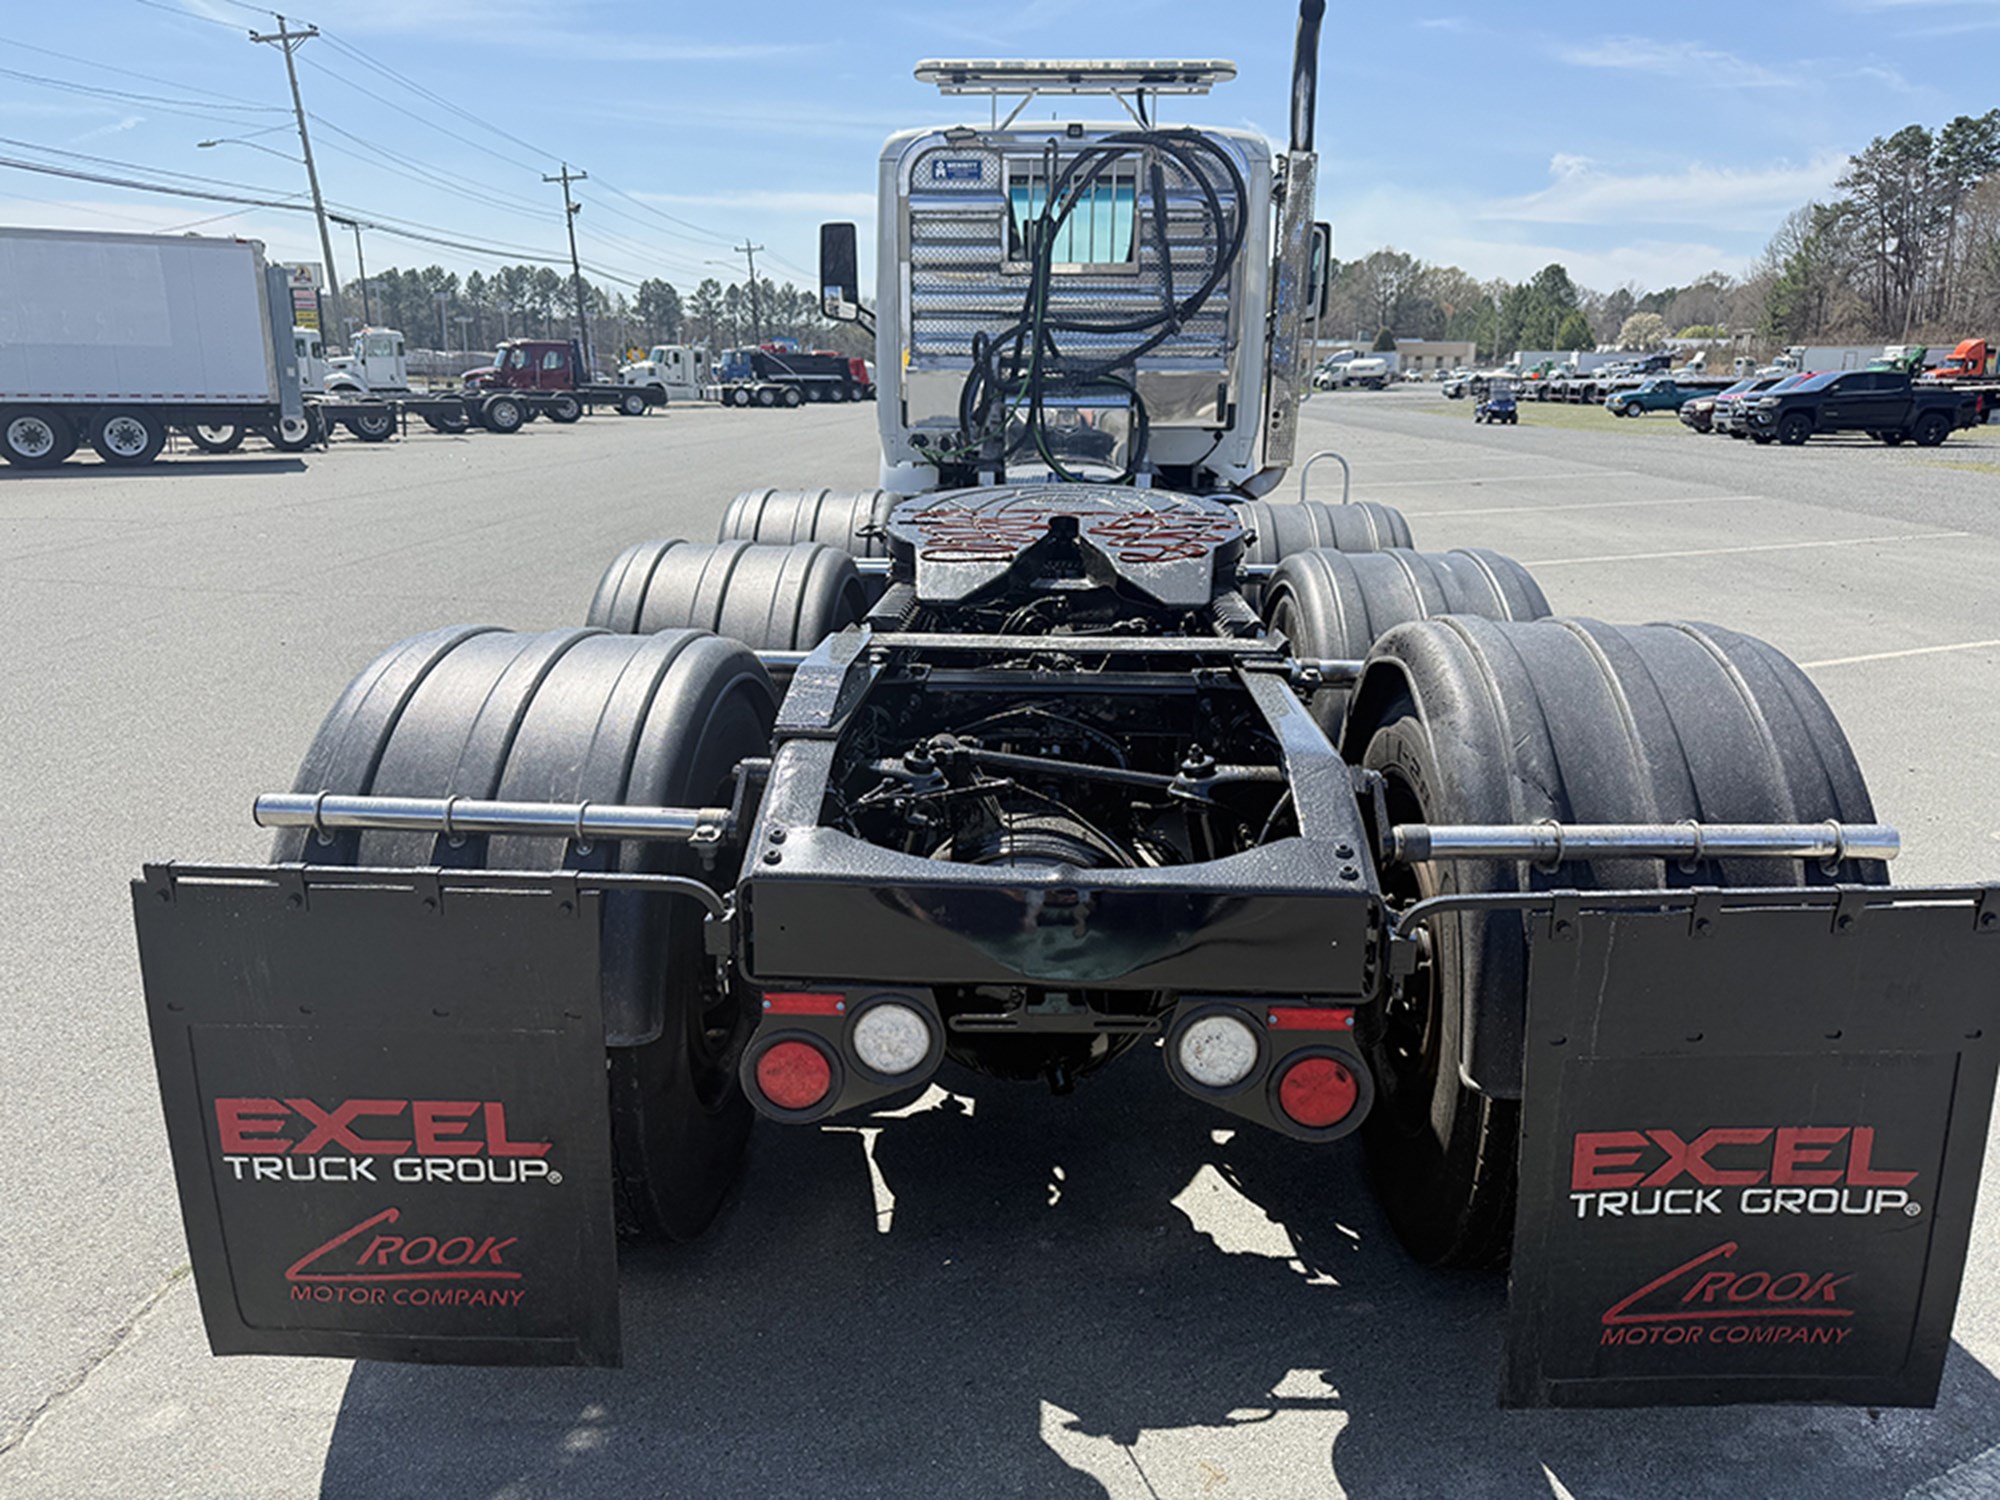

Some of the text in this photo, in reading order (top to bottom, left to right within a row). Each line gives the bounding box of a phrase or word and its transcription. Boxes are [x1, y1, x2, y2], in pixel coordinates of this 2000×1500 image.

[215, 1097, 552, 1157] EXCEL
[223, 1156, 377, 1182] TRUCK
[1571, 1126, 1919, 1190] EXCEL
[1569, 1188, 1722, 1219] TRUCK
[290, 1284, 526, 1308] MOTOR COMPANY
[1600, 1324, 1854, 1346] MOTOR COMPANY
